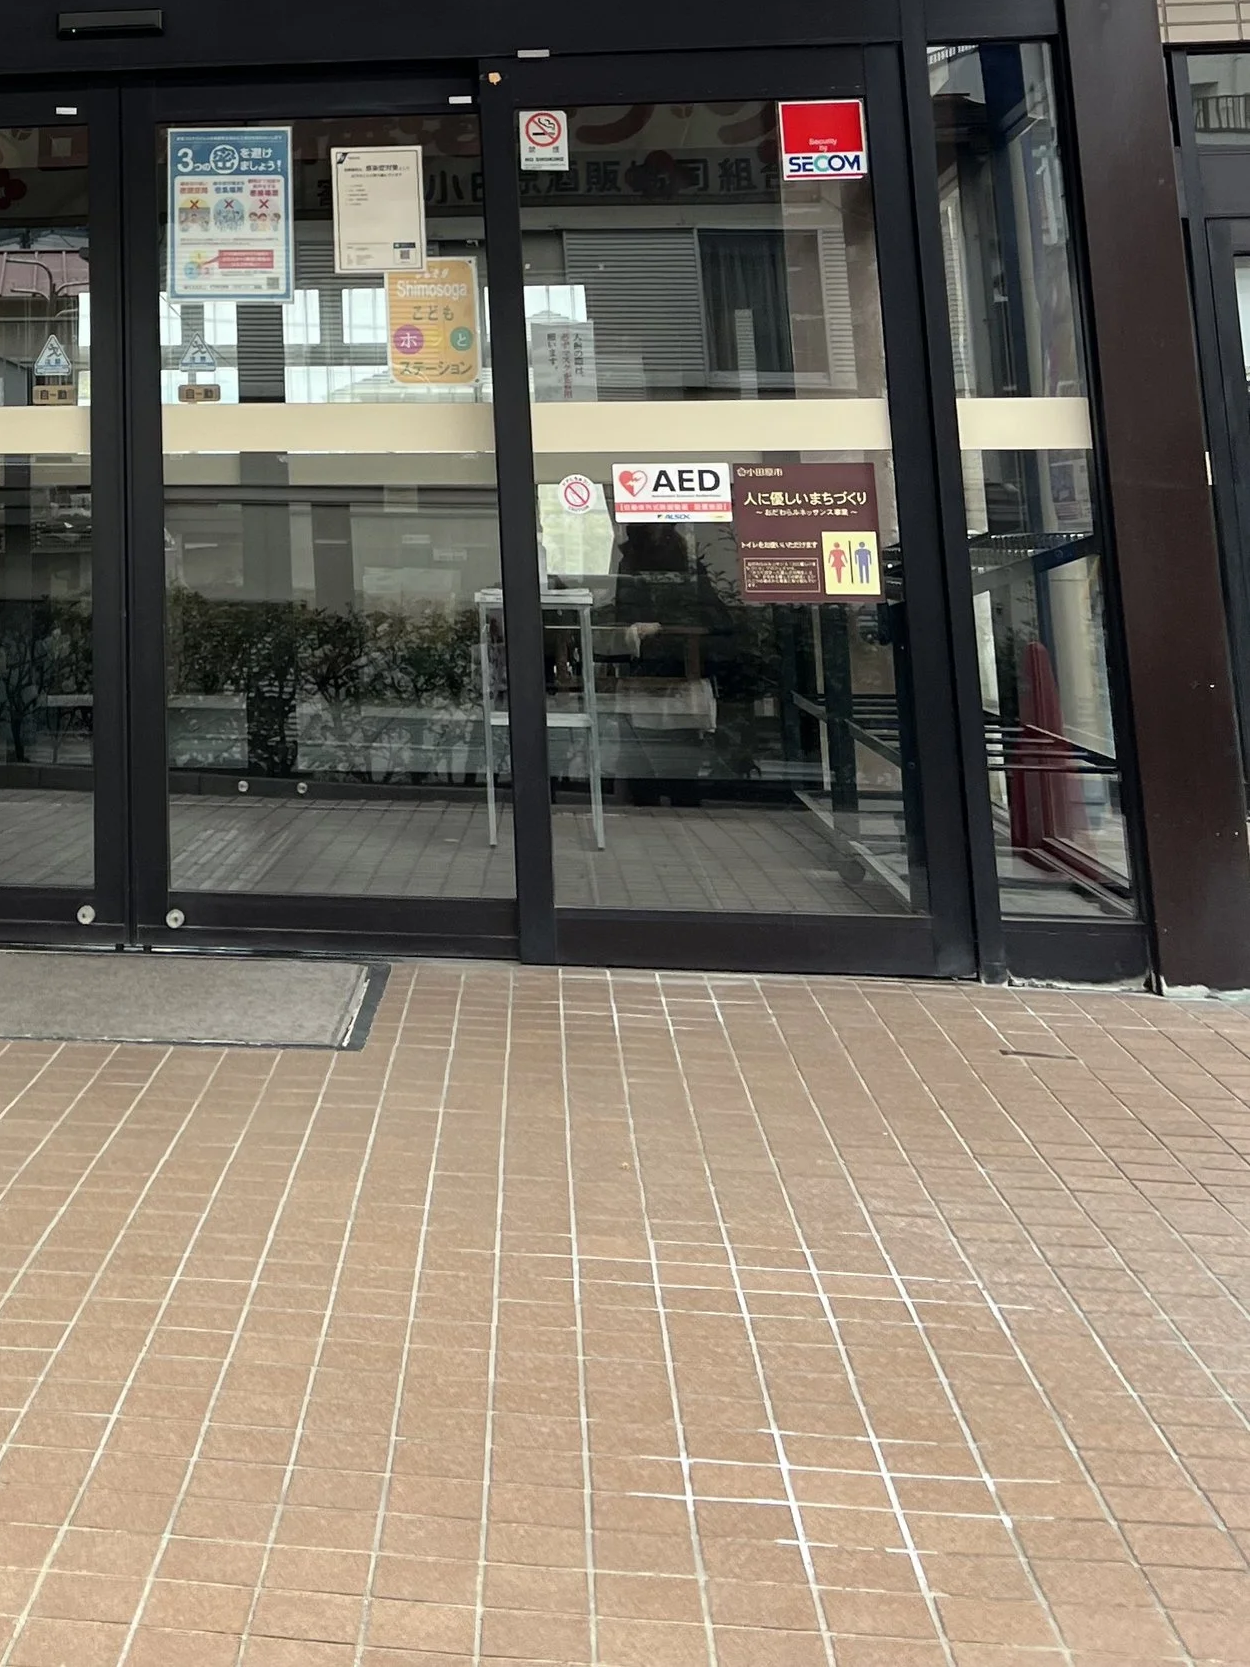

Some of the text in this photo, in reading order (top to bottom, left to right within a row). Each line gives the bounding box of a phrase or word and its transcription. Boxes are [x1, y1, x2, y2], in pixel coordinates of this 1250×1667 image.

[788, 154, 861, 173] SECOM
[396, 279, 468, 301] Shimosoga
[412, 304, 454, 321] こども
[399, 360, 473, 376] ステーション
[652, 469, 721, 492] AED
[744, 490, 867, 506] 人に優しいまちづくり
